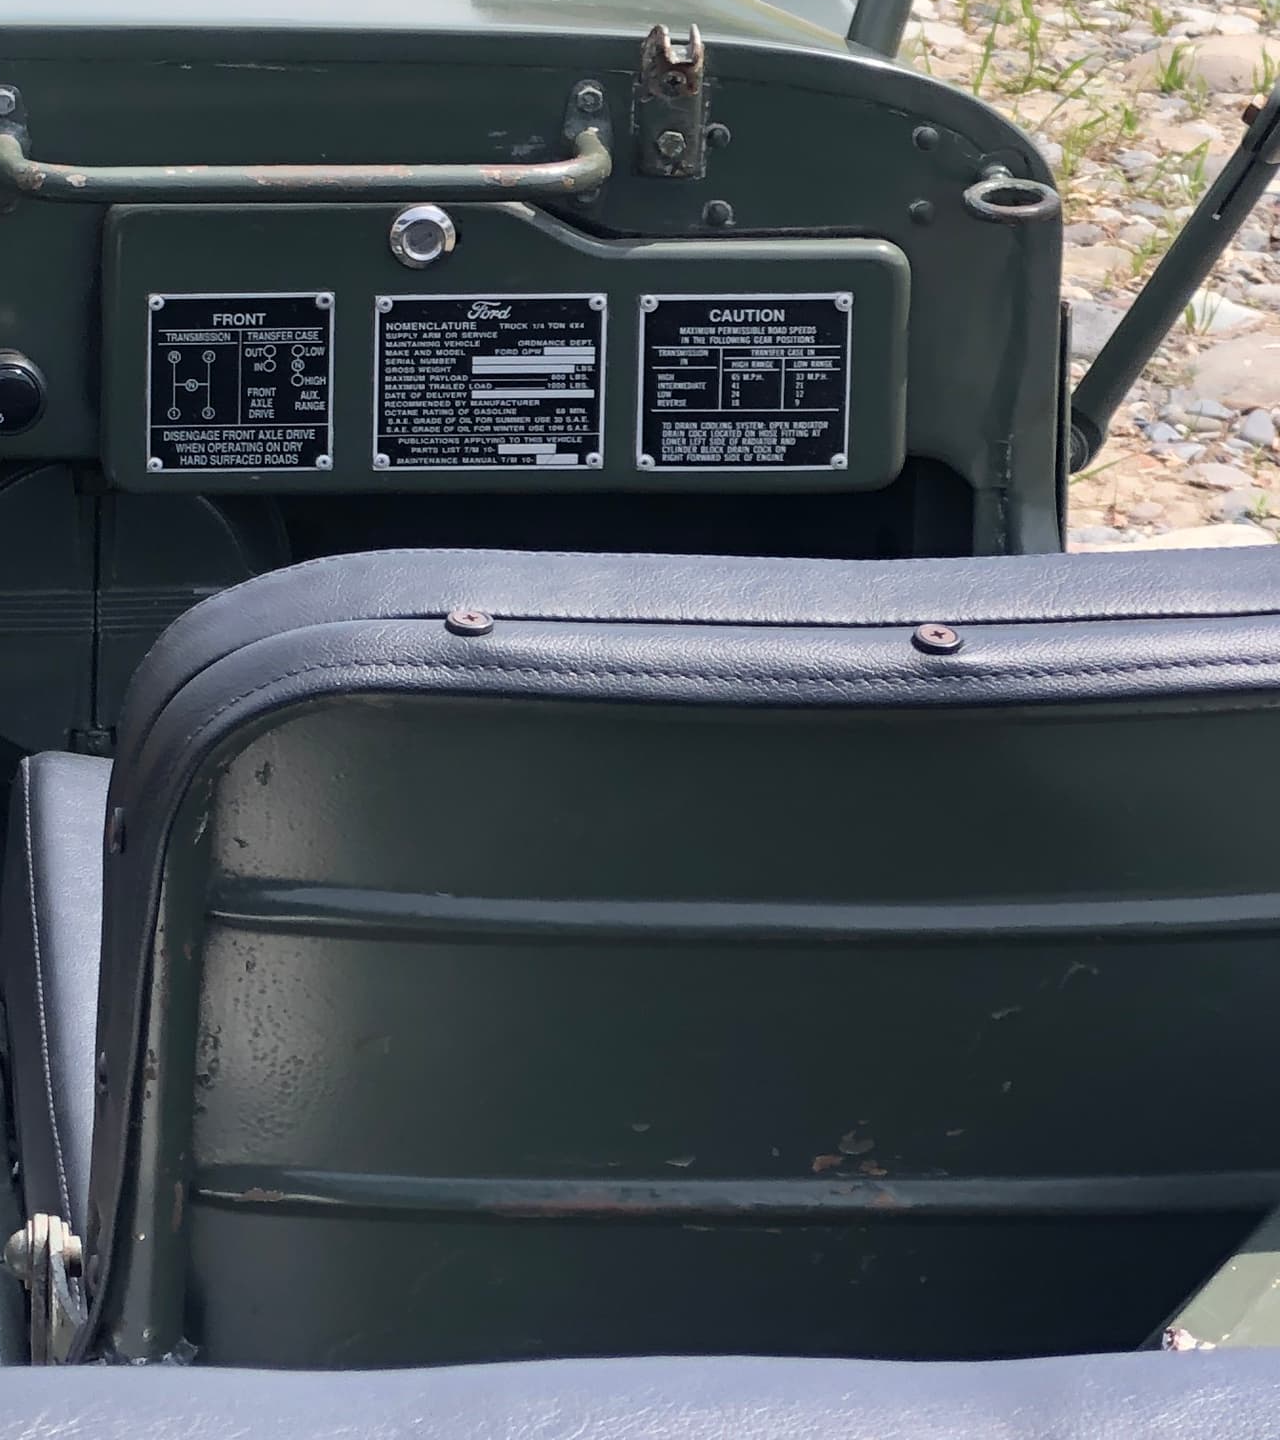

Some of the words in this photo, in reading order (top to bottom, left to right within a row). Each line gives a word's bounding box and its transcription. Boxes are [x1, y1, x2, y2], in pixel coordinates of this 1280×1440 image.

[467, 301, 512, 320] Ford
[213, 313, 266, 326] FRONT
[709, 309, 785, 322] CAUTION
[386, 322, 477, 331] NOMENCLATURE
[680, 327, 715, 335] MAXIMUM
[718, 327, 765, 335] PERMISSIBLE
[768, 326, 787, 334] ROAD
[789, 326, 816, 334] SPEEDS
[166, 333, 231, 342] TRANSMISSION
[247, 332, 293, 340] TRANSFER
[295, 331, 319, 340] CASE
[693, 336, 705, 344] THE
[709, 336, 750, 344] FOLLOWING
[754, 336, 772, 344] GEAR
[776, 335, 815, 343] POSITIONS
[245, 348, 263, 357] OUT
[305, 347, 325, 356] LOW
[254, 363, 263, 371] IN
[305, 377, 326, 385] HIGH
[247, 388, 276, 397] FRONT
[250, 399, 273, 407] AXLE
[295, 402, 325, 410] RANGE
[657, 399, 687, 407] REVERSE
[249, 410, 275, 418] DRIVE
[163, 432, 220, 441] DISENGAGE
[223, 431, 254, 440] FRONT
[258, 430, 283, 439] AXLE
[287, 430, 315, 439] DRIVE
[176, 444, 205, 453] WHEN
[208, 443, 263, 452] OPERATING
[266, 443, 281, 452] ON
[283, 442, 303, 452] DRY
[180, 456, 207, 465] HARD
[210, 455, 262, 465] SURFACED
[265, 455, 298, 464] ROADS
